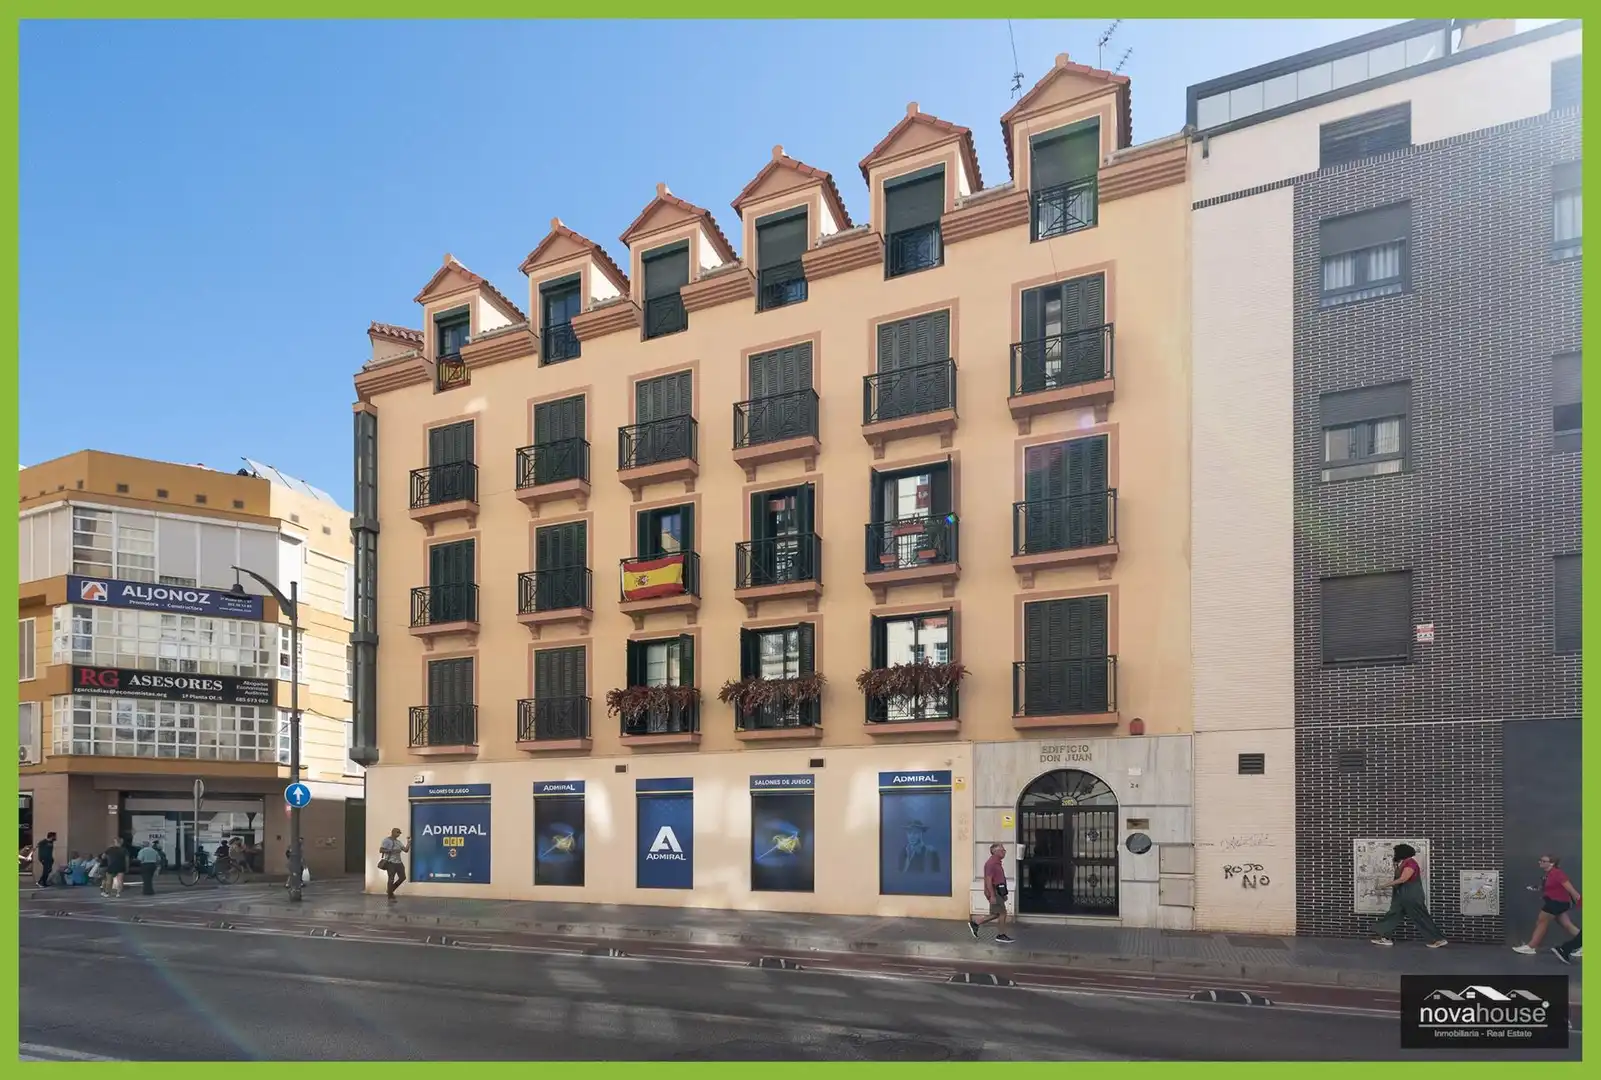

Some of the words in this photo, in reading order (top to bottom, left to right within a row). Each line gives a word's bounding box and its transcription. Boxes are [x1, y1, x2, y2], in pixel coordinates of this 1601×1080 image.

[122, 585, 211, 604] ALJONOZ
[80, 668, 120, 688] RG
[128, 674, 223, 691] ASESORES
[1041, 745, 1089, 754] EDIFICIO
[1040, 754, 1061, 763] DON
[1065, 753, 1092, 761] JUAN
[893, 774, 938, 783] ADMIRAL
[422, 824, 487, 836] ADMIRAL
[646, 853, 687, 861] ADMIRAL
[1223, 863, 1264, 879] ROJO
[1242, 874, 1270, 889] NO
